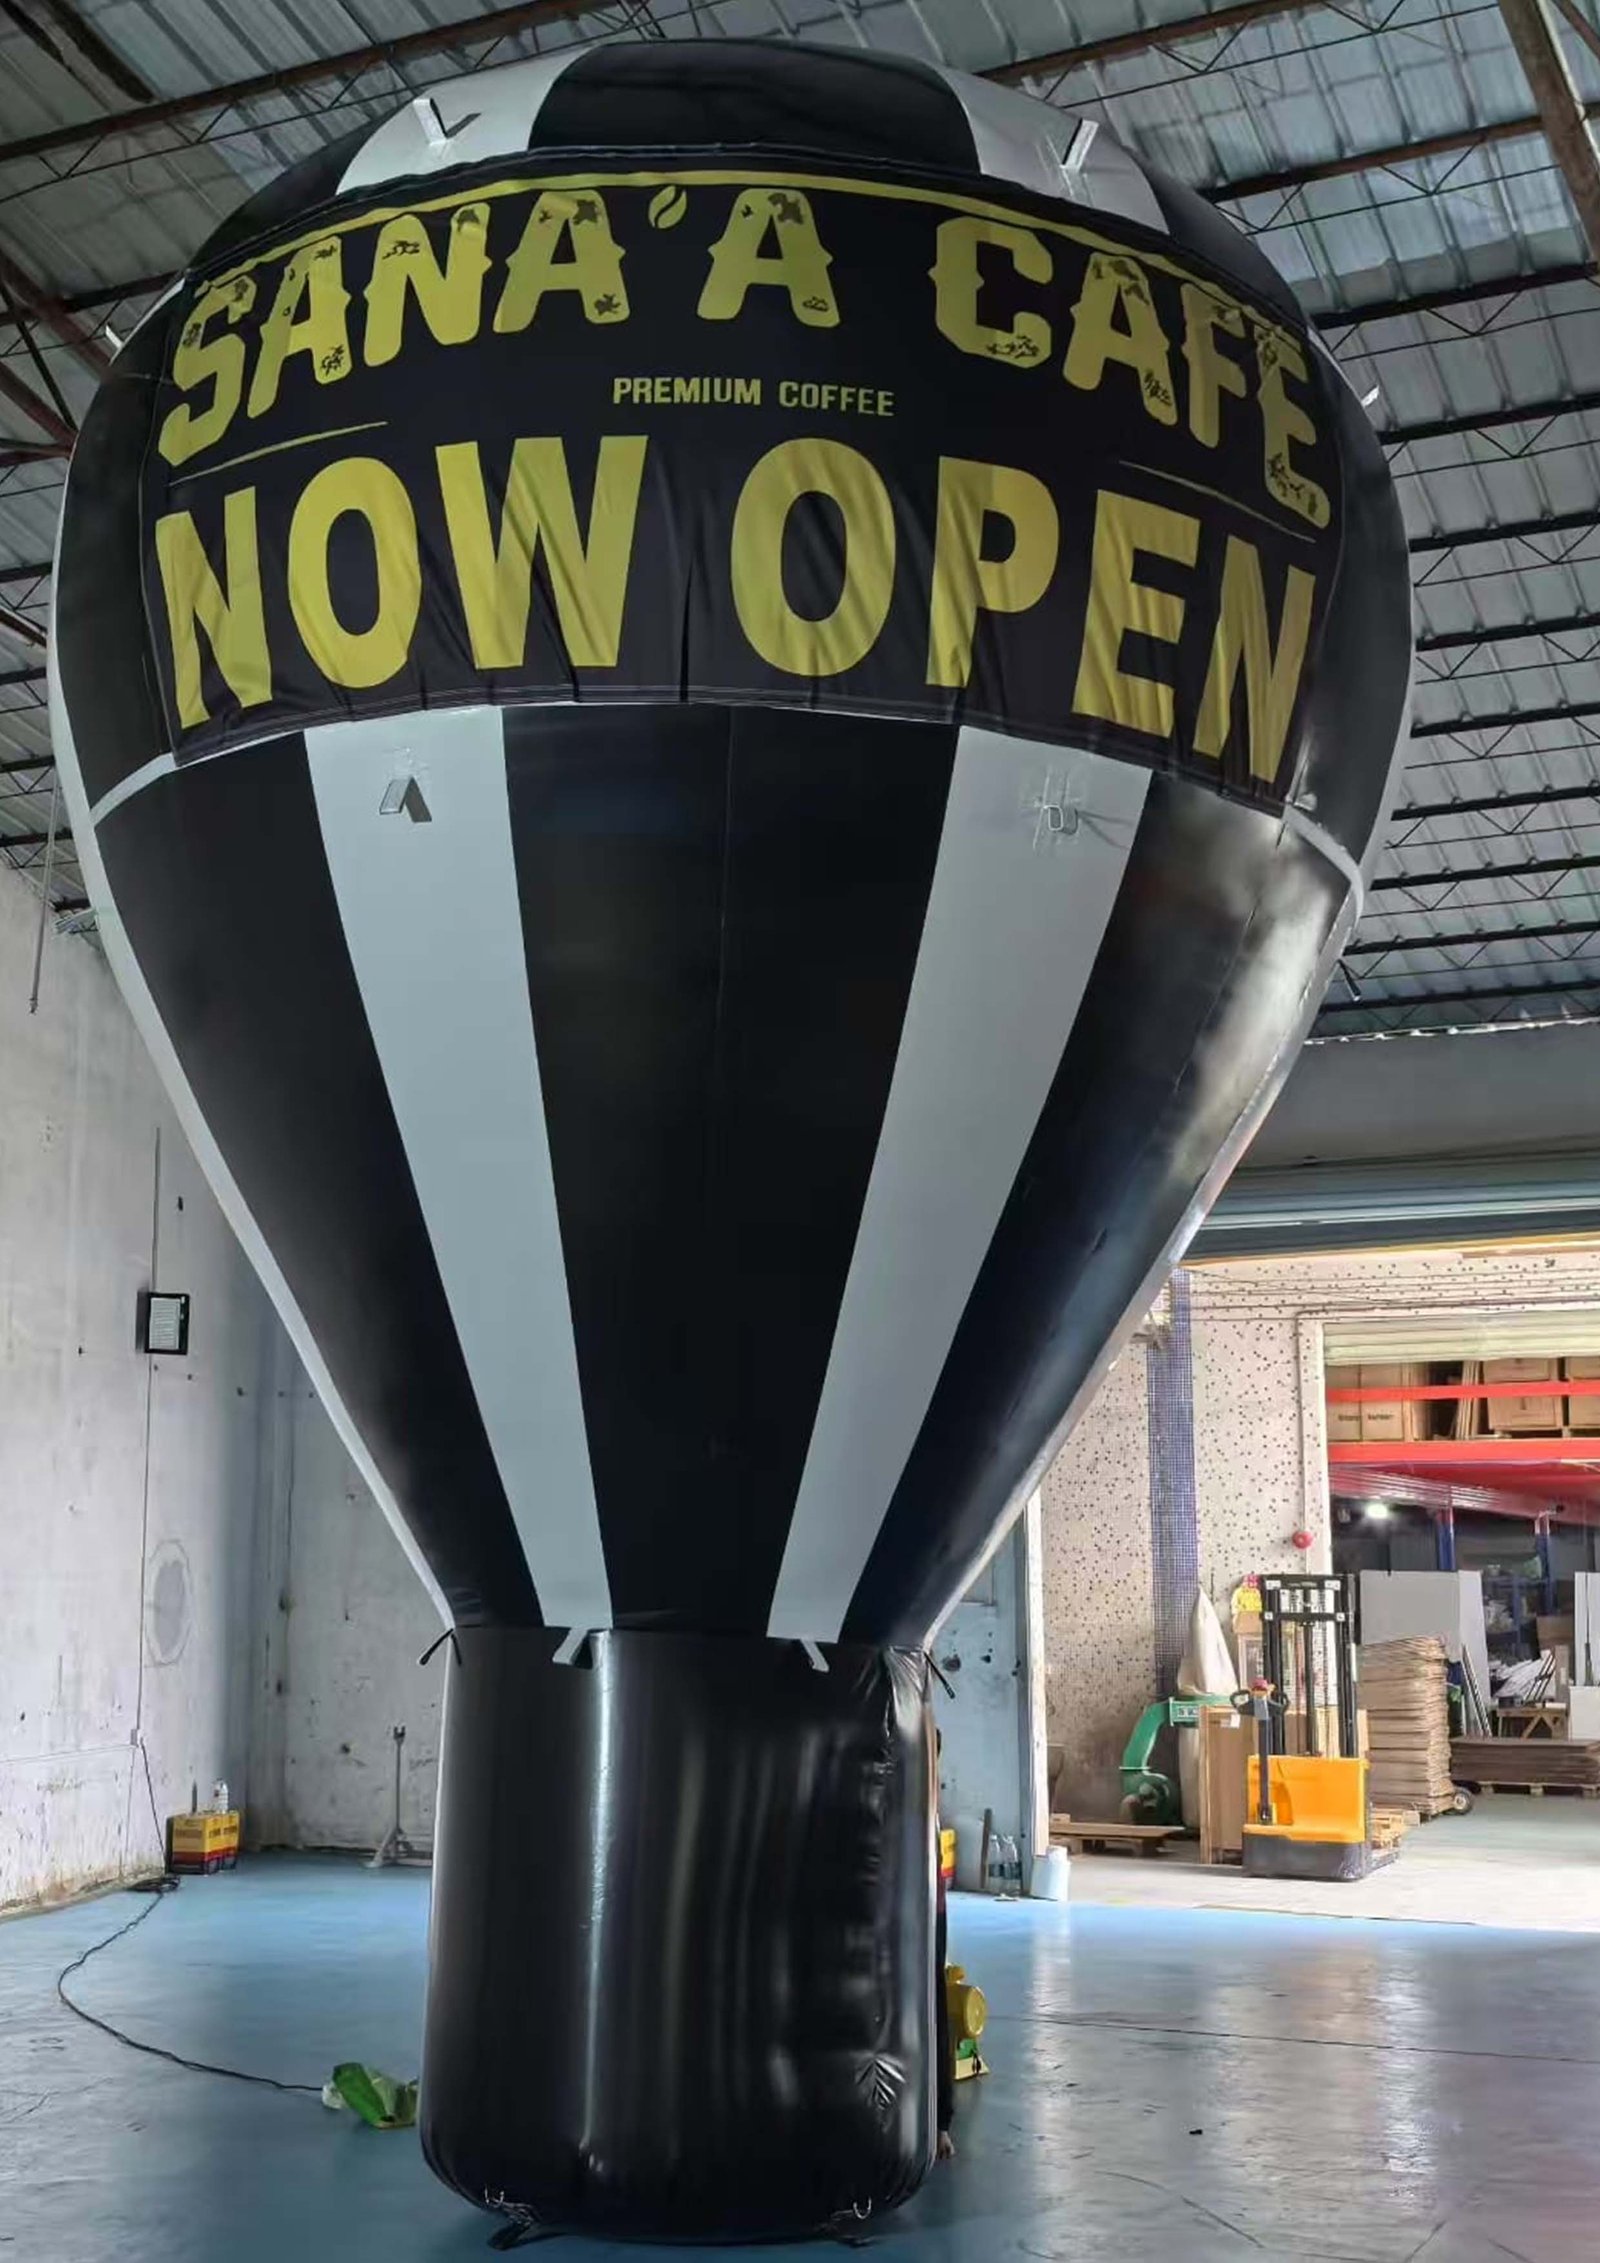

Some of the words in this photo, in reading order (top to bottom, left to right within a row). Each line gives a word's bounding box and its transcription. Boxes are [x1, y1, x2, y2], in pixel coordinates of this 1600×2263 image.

[612, 377, 762, 406] PREMIUM
[779, 380, 895, 417] COFFEE
[927, 216, 1331, 529] CAFE
[154, 435, 649, 730] NOW
[730, 437, 1316, 782] OPEN
